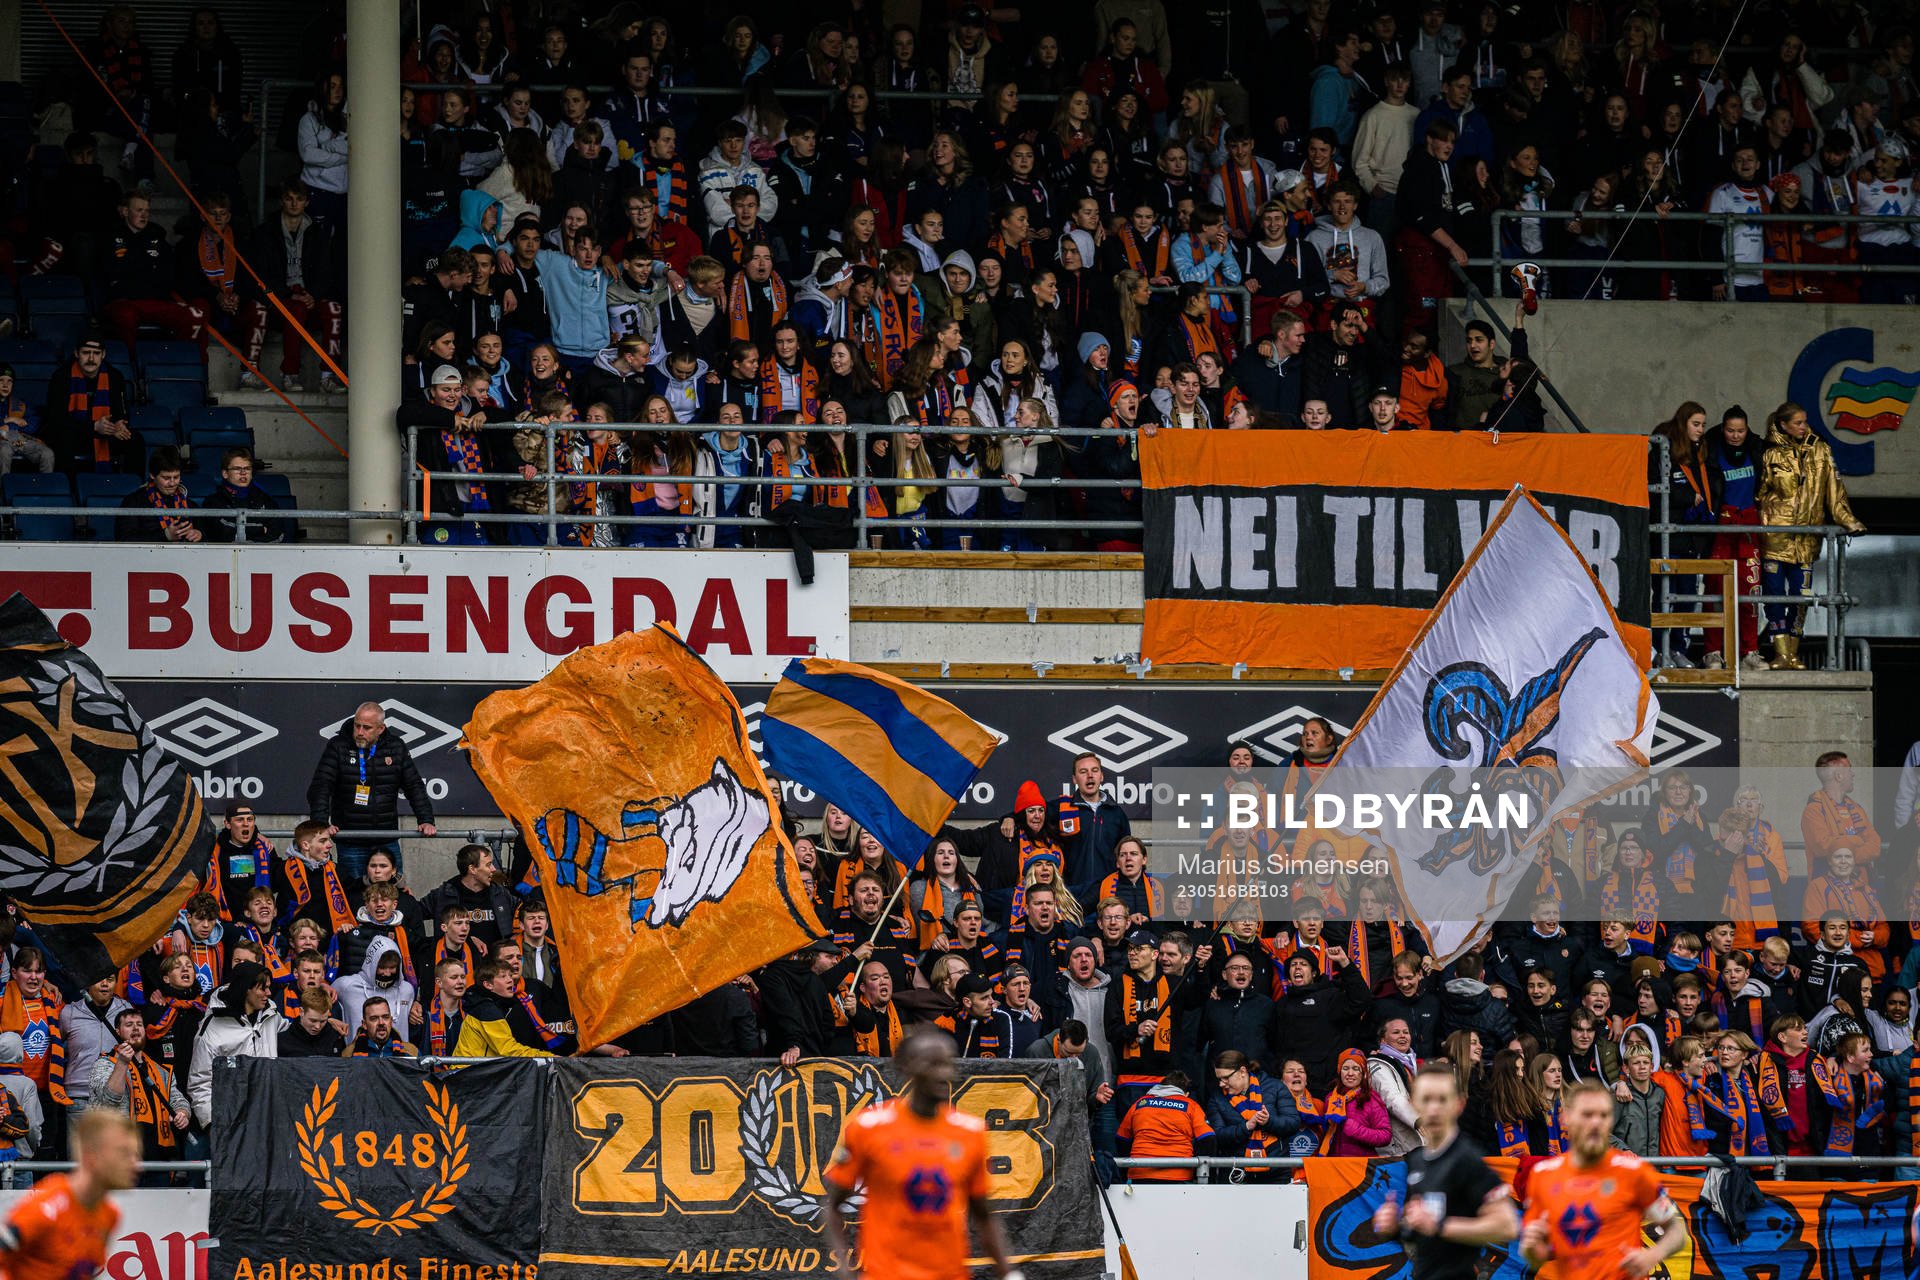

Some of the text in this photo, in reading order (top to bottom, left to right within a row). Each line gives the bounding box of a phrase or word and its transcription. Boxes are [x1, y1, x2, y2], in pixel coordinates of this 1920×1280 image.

[1172, 494, 1621, 608] NEI TIL VR
[127, 571, 817, 656] BUSENGDAL
[200, 770, 264, 799] bro
[1600, 778, 1709, 807] umo
[1149, 1099, 1186, 1110] TAFJORD
[331, 1130, 436, 1168] 1848
[574, 1080, 746, 1207] 20
[234, 1256, 415, 1280] Aalesunds
[668, 1247, 819, 1274] AALESUND
